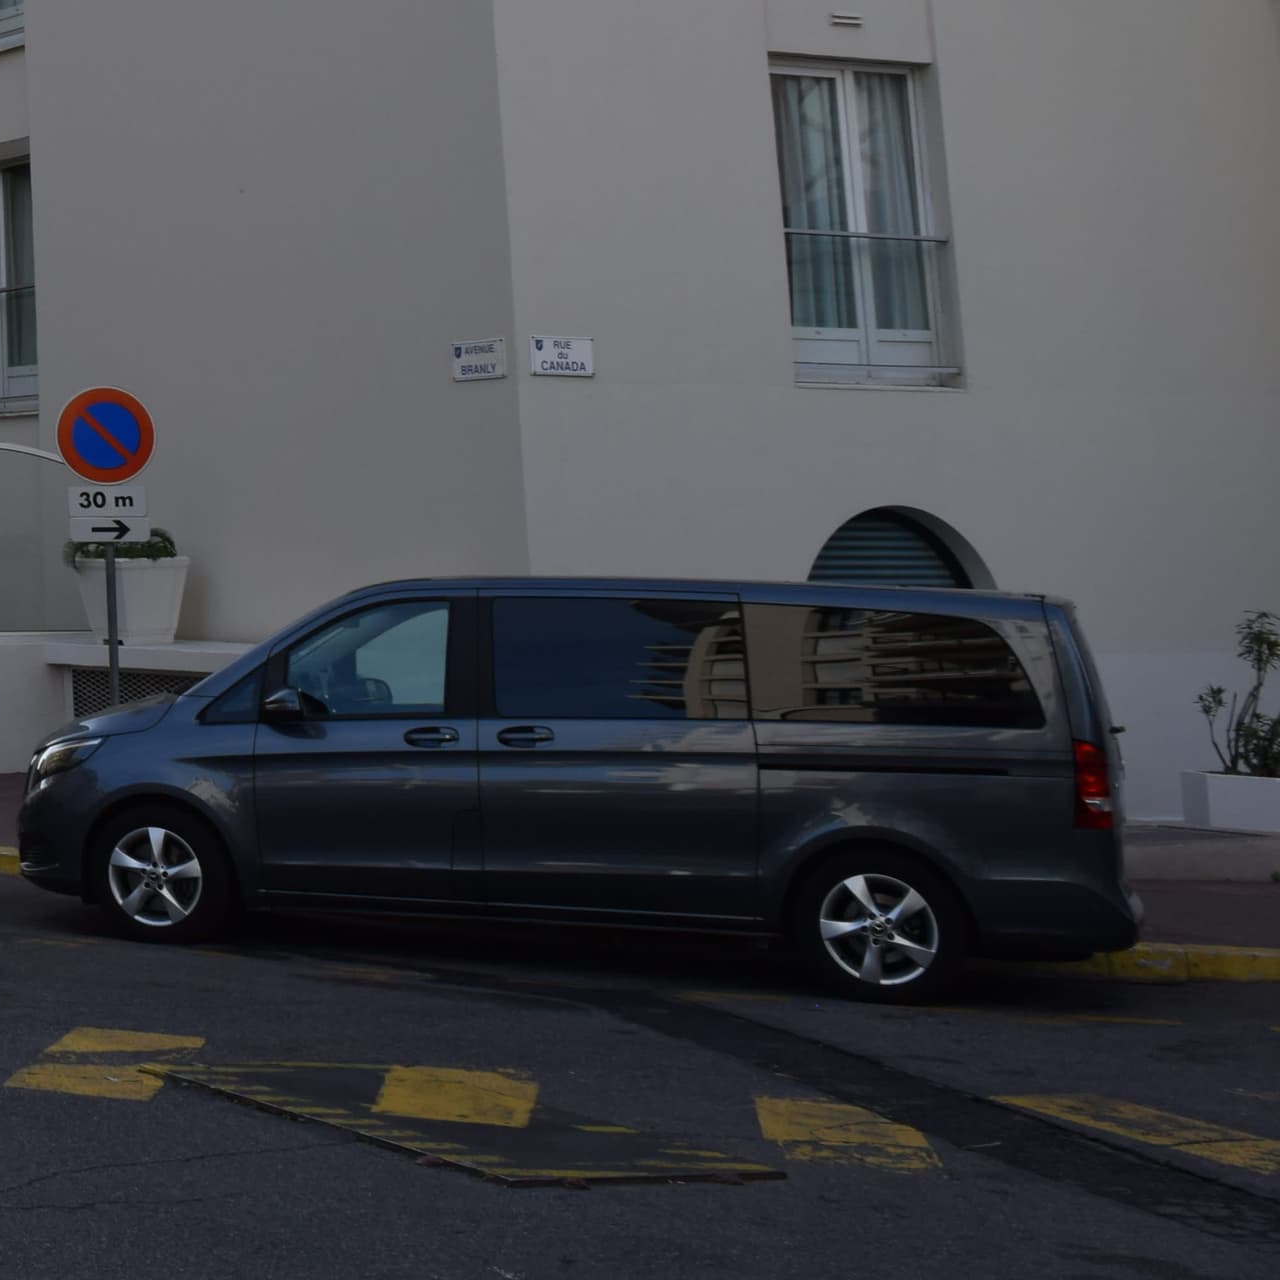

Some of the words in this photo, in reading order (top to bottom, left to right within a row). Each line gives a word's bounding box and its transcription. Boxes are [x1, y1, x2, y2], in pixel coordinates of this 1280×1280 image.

[464, 343, 495, 355] AVENUE
[553, 340, 573, 350] RUE
[557, 351, 568, 360] du
[461, 363, 496, 376] BRANLY
[541, 360, 586, 372] CANADA
[79, 491, 106, 508] 30
[114, 495, 134, 507] m
